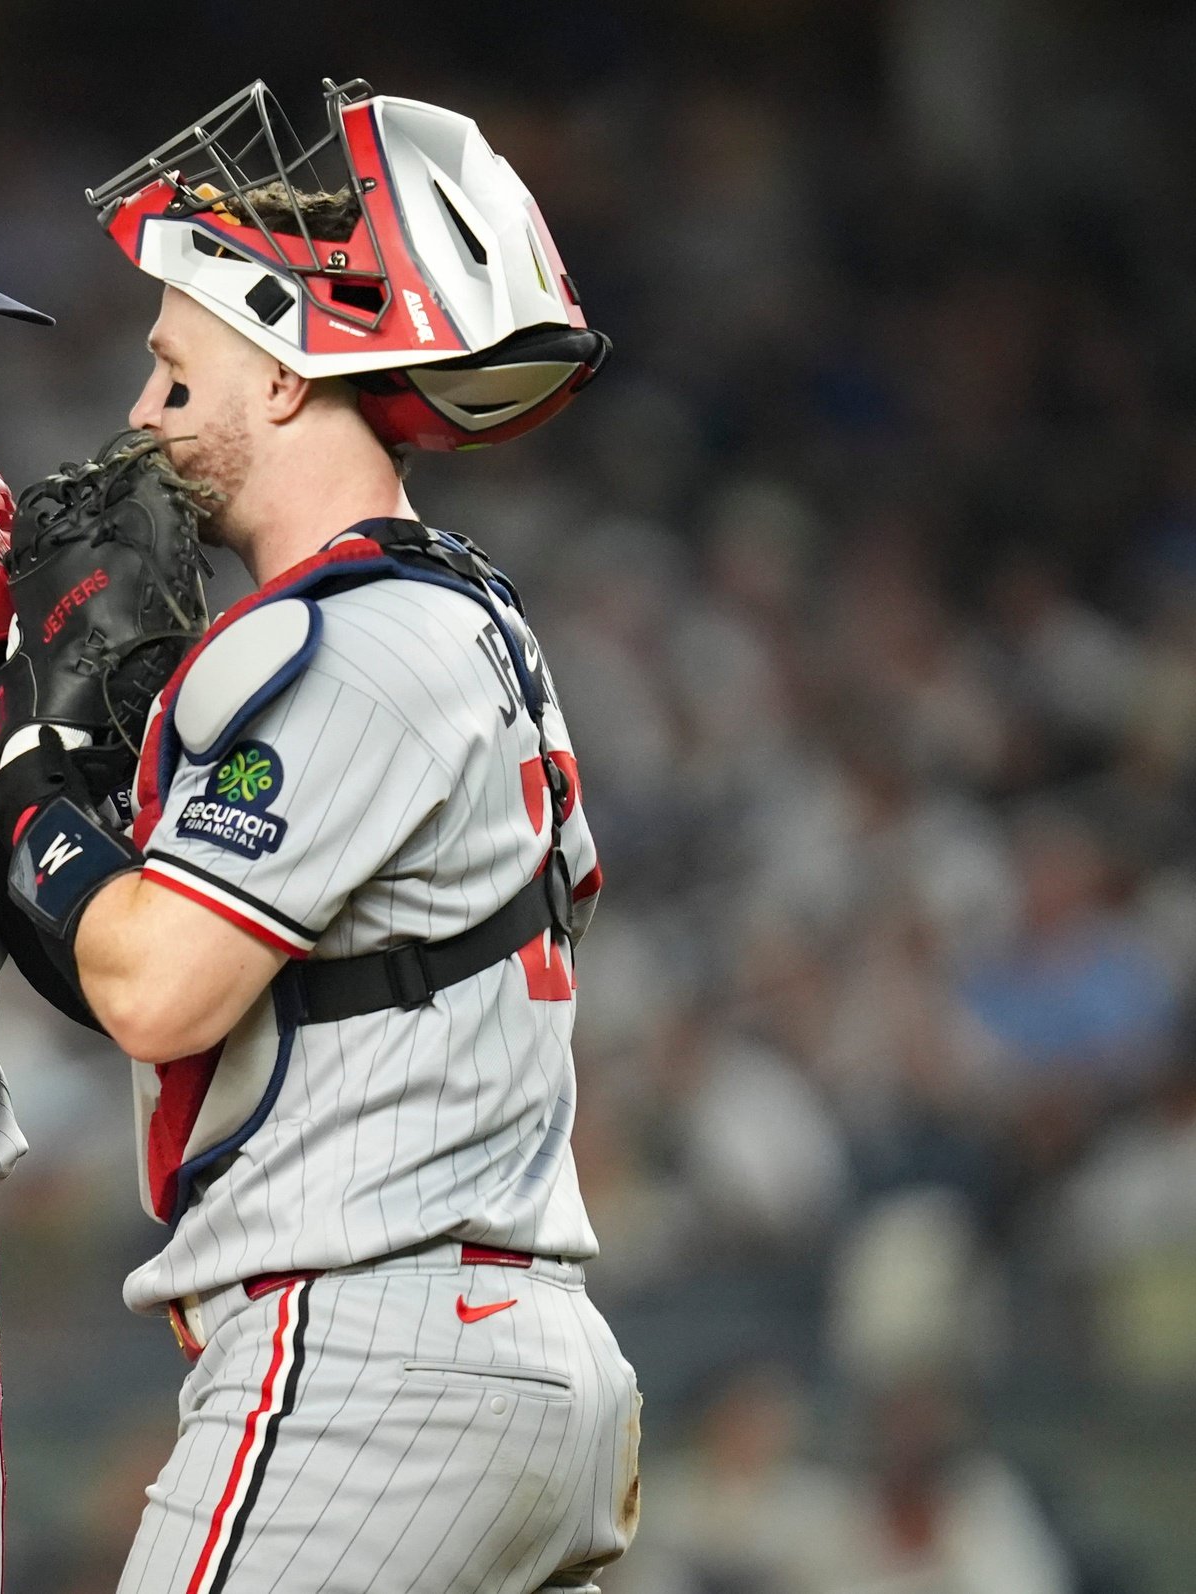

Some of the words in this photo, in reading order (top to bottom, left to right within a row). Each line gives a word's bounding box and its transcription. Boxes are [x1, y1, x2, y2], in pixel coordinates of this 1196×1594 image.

[43, 568, 110, 643] JEFFERS
[183, 802, 278, 843] securian
[185, 819, 256, 850] FINANCIAL
